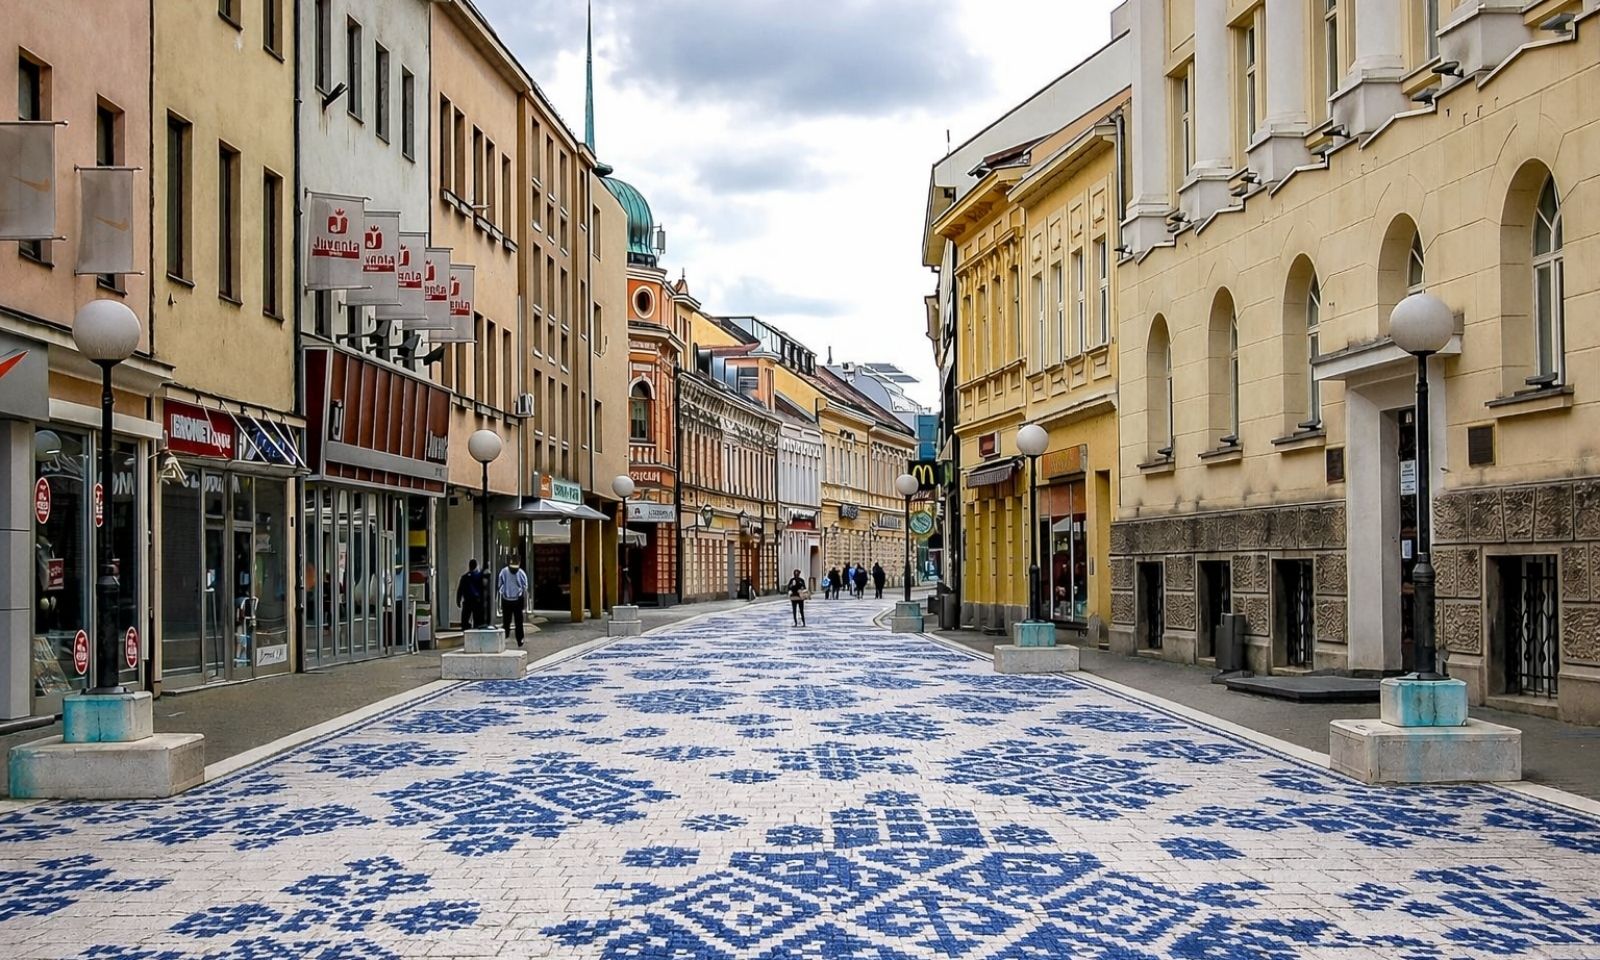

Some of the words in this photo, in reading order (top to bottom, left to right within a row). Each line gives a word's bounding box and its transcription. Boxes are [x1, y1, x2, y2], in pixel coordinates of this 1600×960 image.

[313, 236, 360, 252] Juventa
[365, 254, 395, 266] venta
[398, 271, 421, 282] enta
[424, 285, 447, 295] enta
[450, 301, 471, 310] enta
